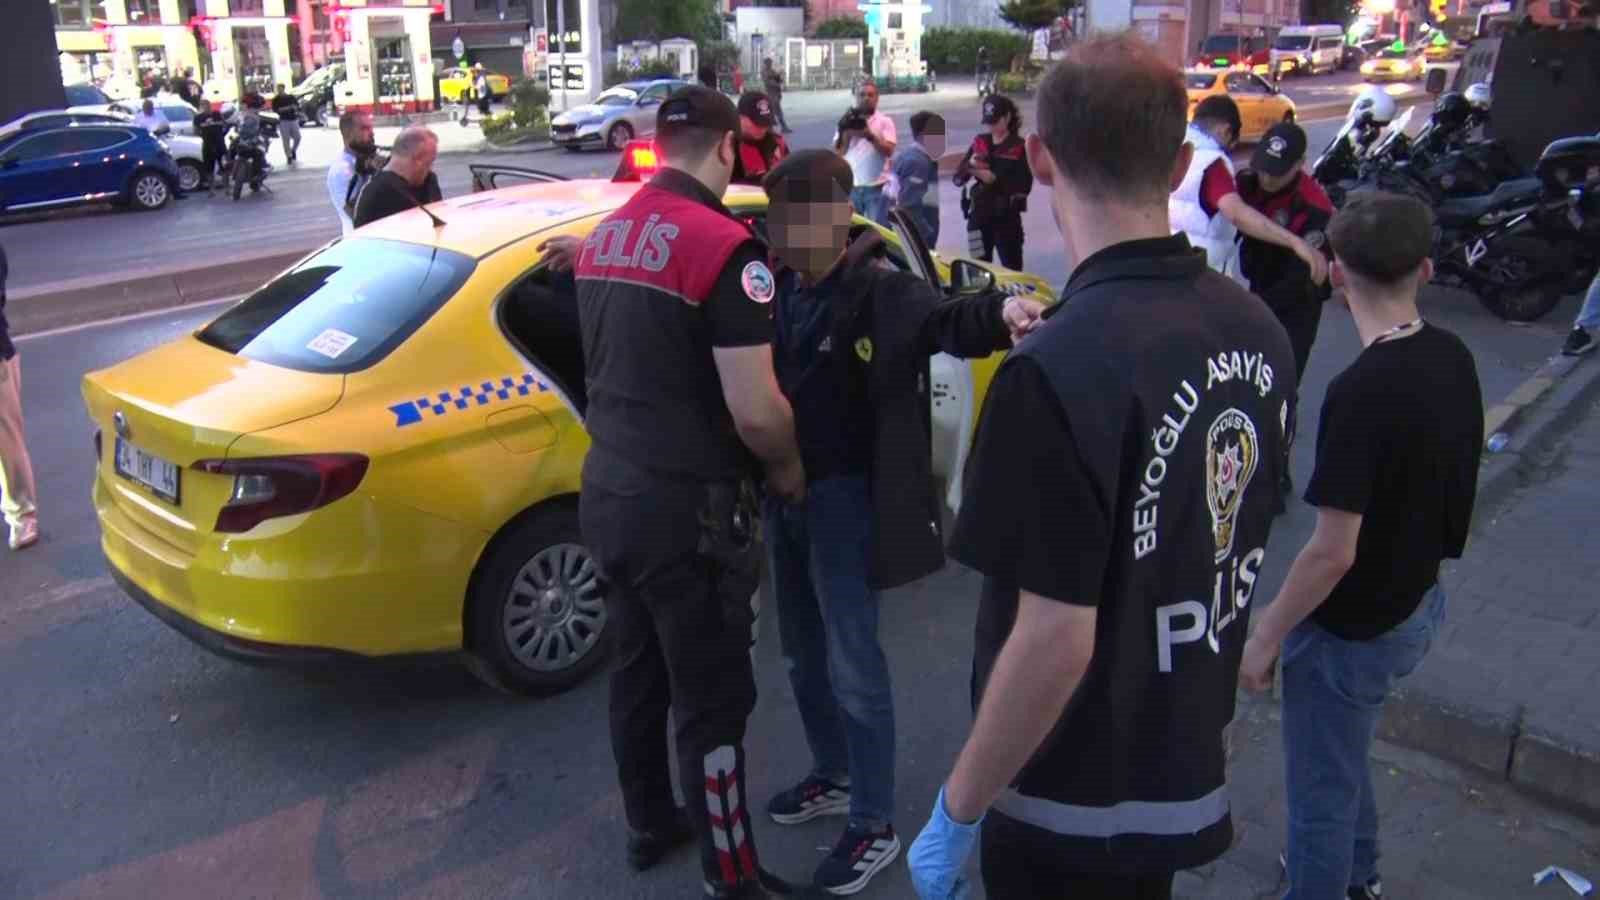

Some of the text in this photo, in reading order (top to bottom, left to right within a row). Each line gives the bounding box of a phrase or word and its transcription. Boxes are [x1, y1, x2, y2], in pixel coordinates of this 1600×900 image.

[578, 213, 680, 272] POLİS
[1133, 350, 1273, 561] BEYOĞLU ASAYİŞ
